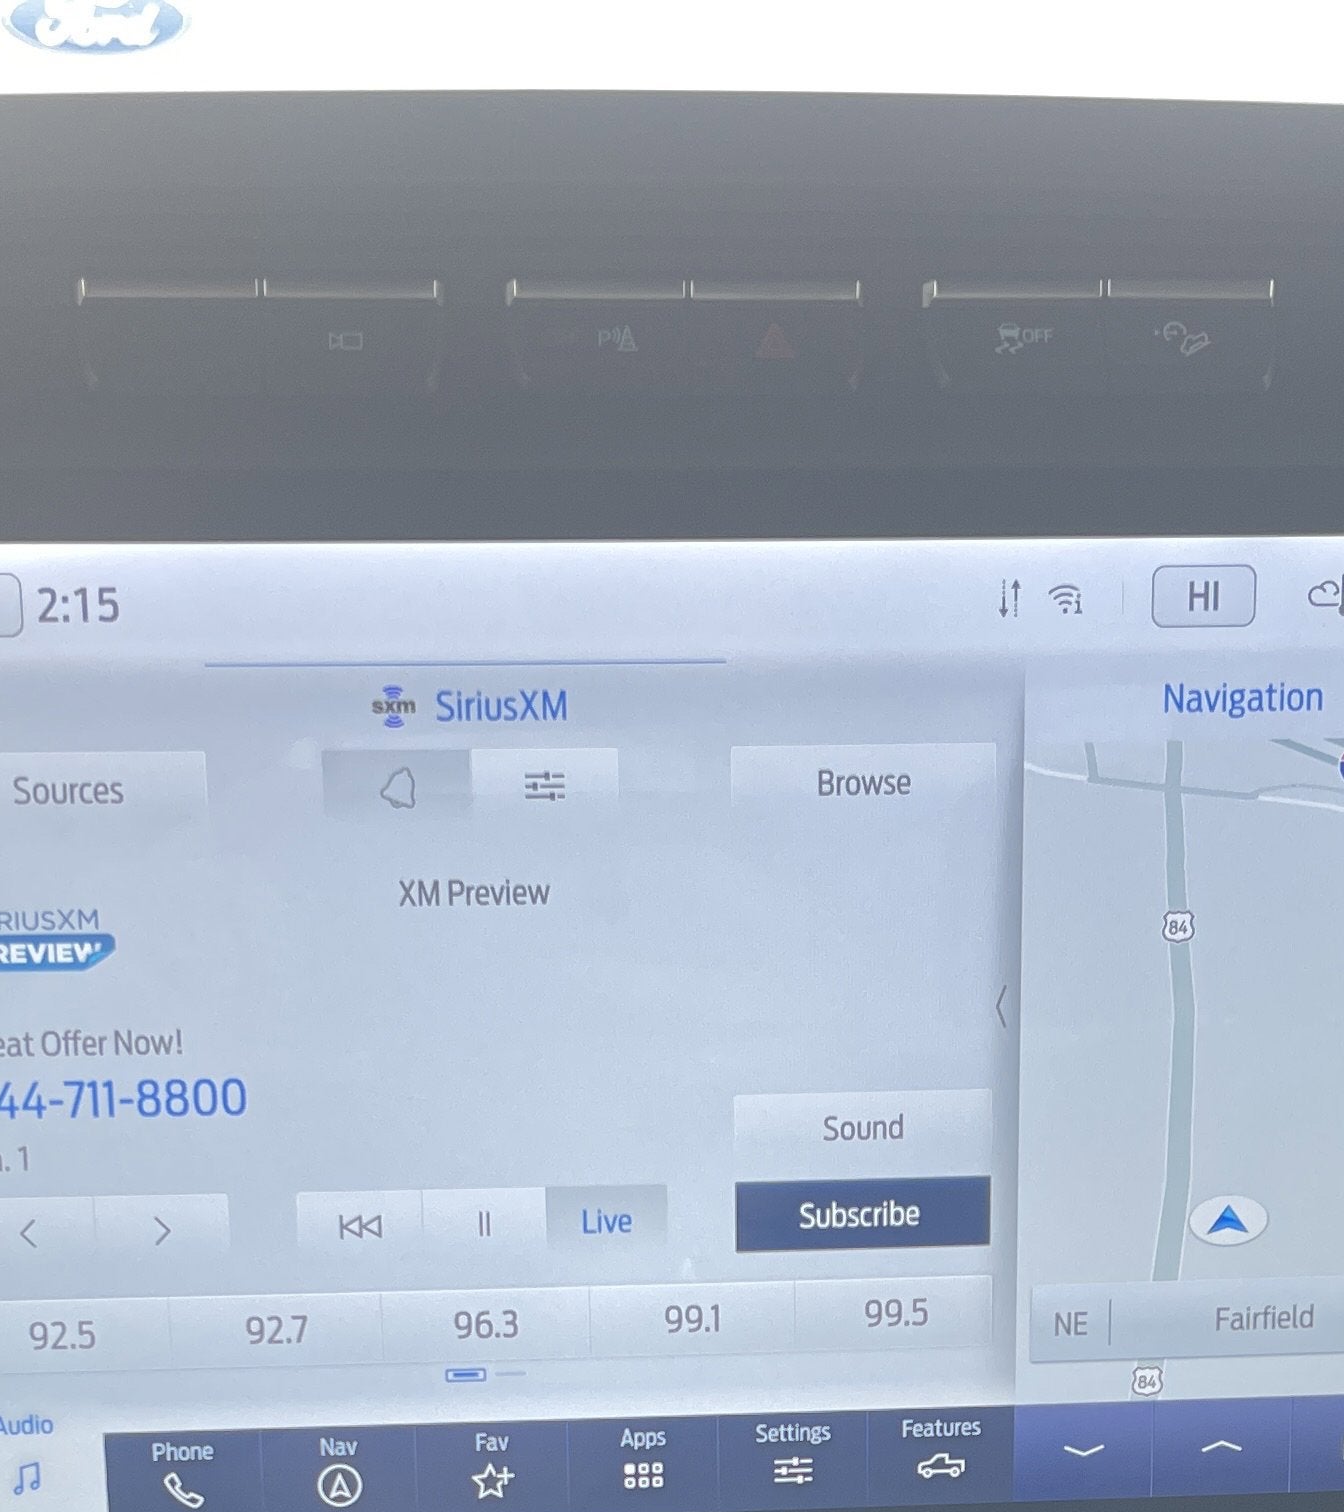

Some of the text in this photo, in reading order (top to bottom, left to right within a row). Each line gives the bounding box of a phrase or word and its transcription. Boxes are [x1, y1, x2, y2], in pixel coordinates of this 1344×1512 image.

[1021, 327, 1054, 344] OFF
[37, 586, 120, 624] 2:15
[1188, 580, 1220, 612] HI
[435, 689, 568, 724] SiriusXM
[1163, 681, 1325, 719] Navigation
[12, 775, 125, 806] Sources
[817, 768, 912, 798] Browse
[399, 878, 551, 908] XM Preview
[1168, 917, 1189, 937] 84
[41, 1028, 108, 1058] Offer
[113, 1027, 184, 1057] Now!
[822, 1113, 905, 1143] Sound
[17, 1145, 30, 1172] 1
[581, 1207, 633, 1237] Live
[798, 1199, 921, 1231] Subscribe
[453, 1308, 520, 1341] 96.3
[663, 1304, 723, 1334] 99.1
[864, 1297, 930, 1329] 99.5
[1054, 1310, 1089, 1338] NE
[1215, 1302, 1315, 1333] Fairfield
[28, 1319, 97, 1352] 92.5
[244, 1314, 309, 1346] 92.7
[1137, 1372, 1157, 1391] 84
[475, 1431, 510, 1453] Fav
[620, 1426, 667, 1450] Apps
[755, 1420, 832, 1445] Settings
[901, 1416, 982, 1440] Features
[151, 1441, 215, 1464] Phone
[319, 1436, 359, 1458] Nav
